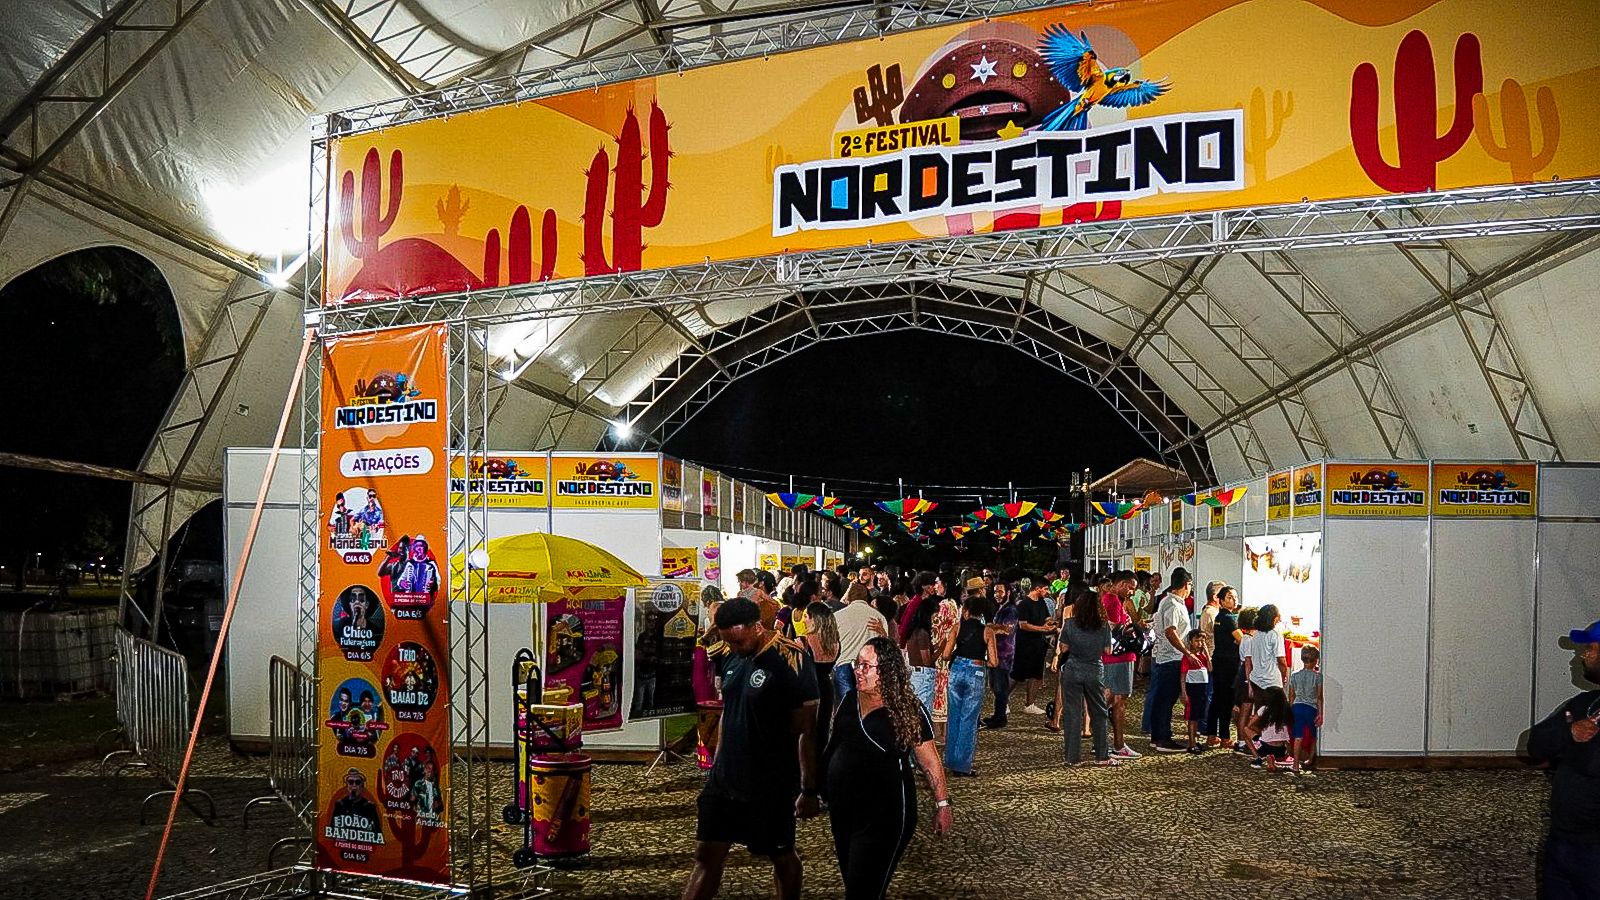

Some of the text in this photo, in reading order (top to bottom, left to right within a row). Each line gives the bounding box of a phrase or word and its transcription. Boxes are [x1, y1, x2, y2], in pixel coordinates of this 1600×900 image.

[840, 122, 952, 157] 2º FESTIVAL
[779, 118, 1236, 229] NORDESTINO
[337, 402, 436, 427] NORDESTINO
[352, 454, 420, 473] ATRAÇÕES
[559, 482, 652, 495] NORDESTINO
[1333, 491, 1424, 504] NORDESTINO
[1441, 491, 1531, 504] NORDESTINO
[345, 554, 370, 563] DIA 6/5
[398, 609, 411, 618] DIA
[343, 626, 373, 639] Chico
[347, 651, 358, 659] DIA
[399, 648, 416, 662] TRIO
[418, 691, 429, 705] D2
[398, 711, 424, 720] DIA 7/5
[344, 745, 356, 753] DIA
[387, 800, 399, 808] DIA
[340, 814, 369, 829] JOÃO
[325, 826, 385, 845] BANDEIRA
